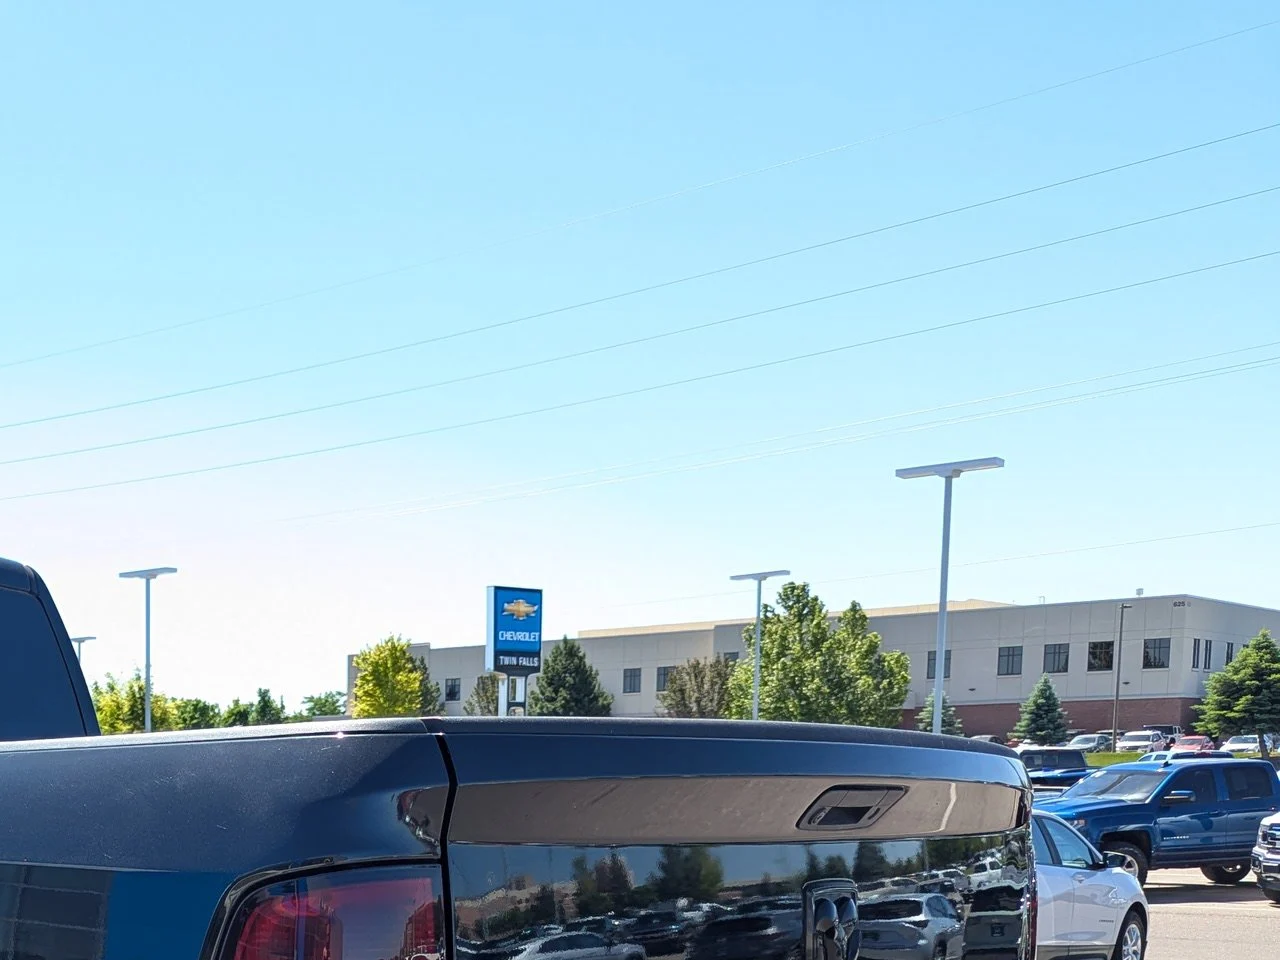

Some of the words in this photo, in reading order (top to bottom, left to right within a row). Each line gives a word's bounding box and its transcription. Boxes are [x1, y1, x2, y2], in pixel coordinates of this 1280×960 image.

[498, 631, 540, 642] CHEVROLET
[499, 655, 517, 666] TWIN
[518, 656, 539, 667] FALLS
